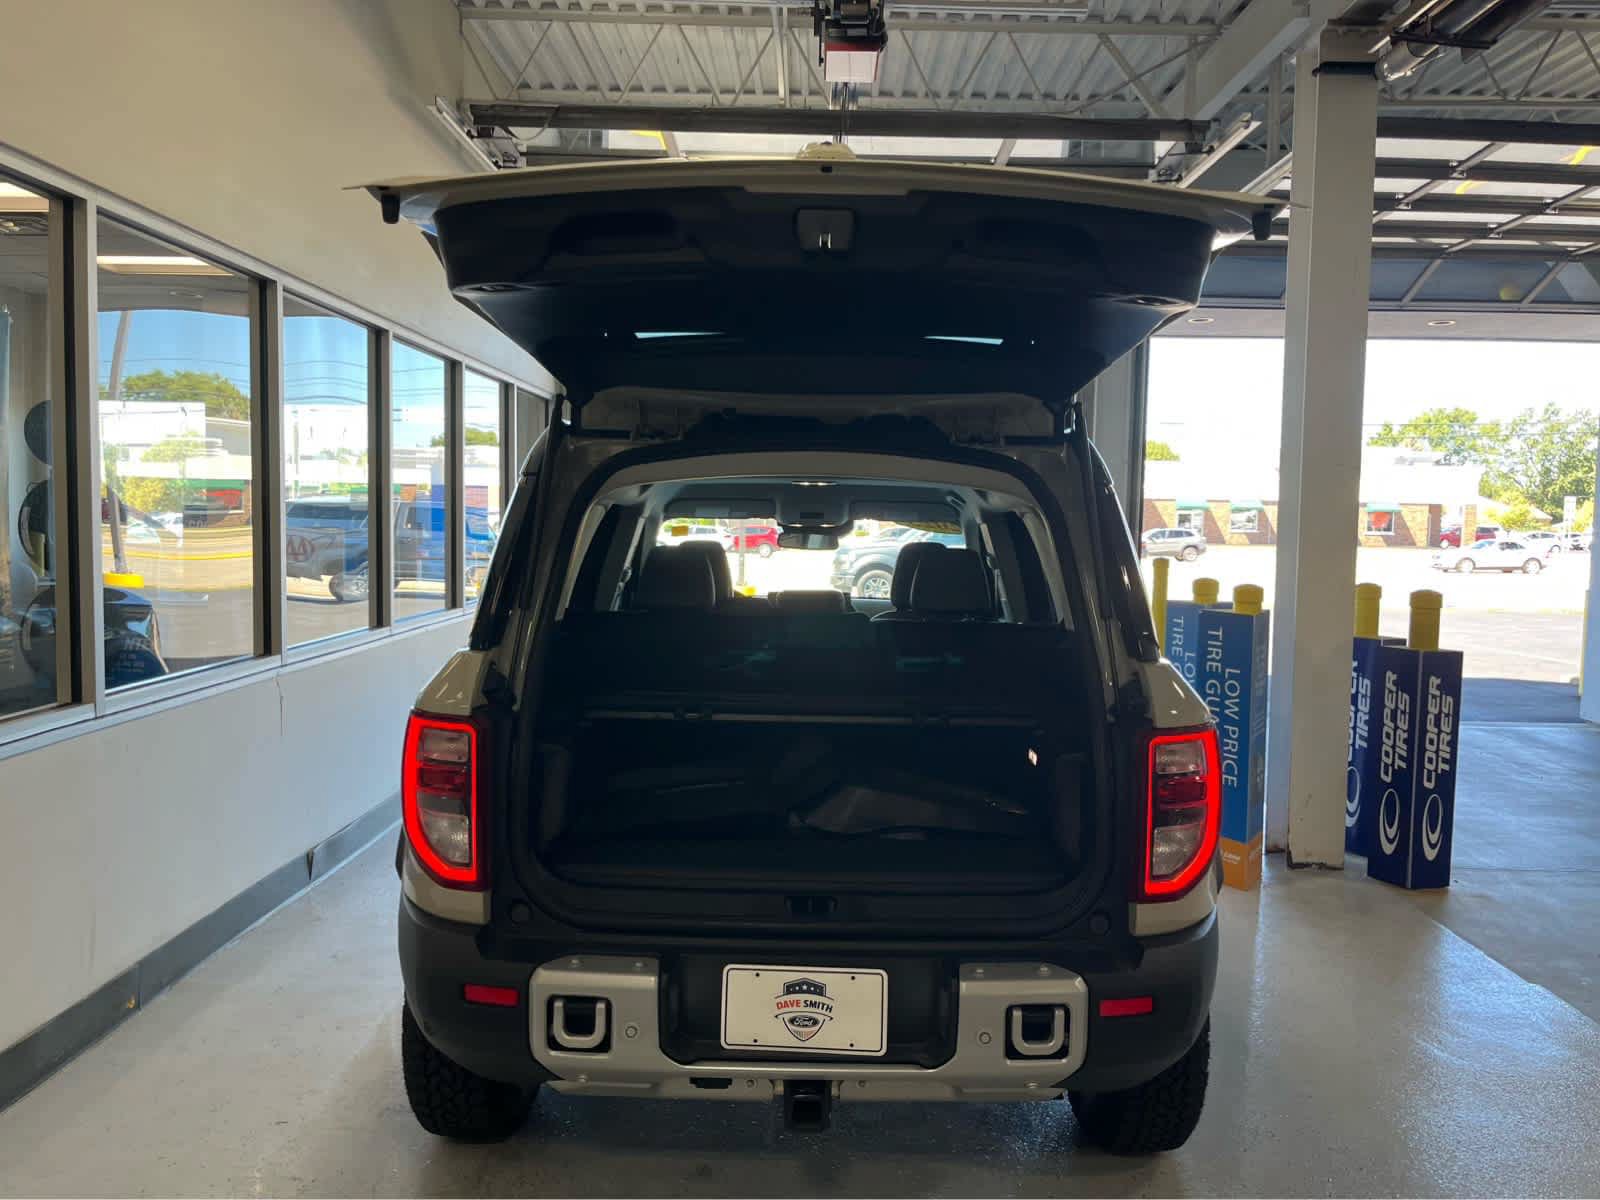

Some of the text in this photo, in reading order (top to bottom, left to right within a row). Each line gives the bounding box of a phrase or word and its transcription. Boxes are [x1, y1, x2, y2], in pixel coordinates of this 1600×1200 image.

[1172, 615, 1184, 657] TIRE
[1184, 651, 1196, 684] LO
[1206, 625, 1223, 673] TIRE
[1222, 668, 1241, 788] LOW PRICE
[1355, 676, 1371, 750] TIRES
[1380, 670, 1398, 783] COOPER
[1394, 691, 1410, 770] TIRES
[1423, 675, 1442, 789] COOPER
[1437, 694, 1454, 774] TIRES
[776, 999, 833, 1013] DAVE SMITH
